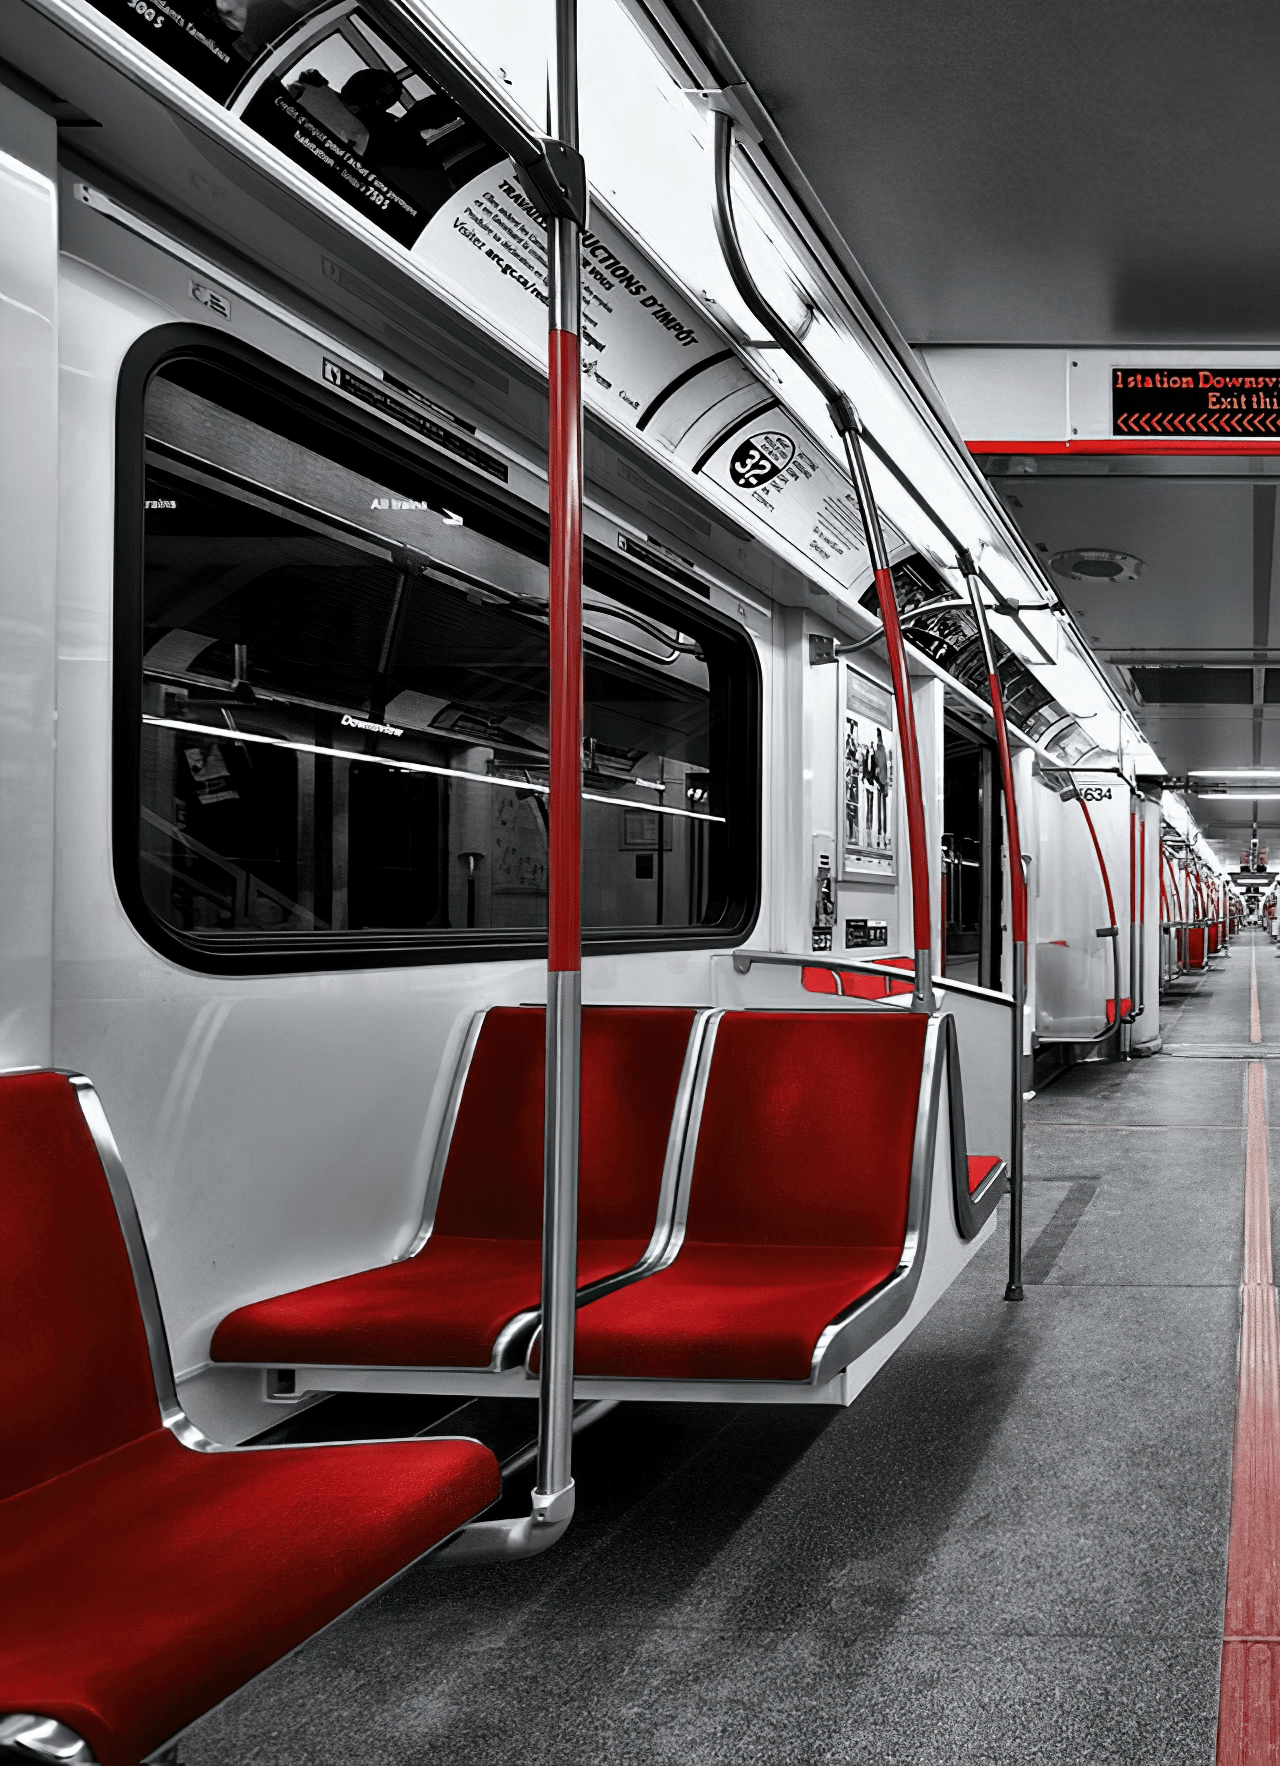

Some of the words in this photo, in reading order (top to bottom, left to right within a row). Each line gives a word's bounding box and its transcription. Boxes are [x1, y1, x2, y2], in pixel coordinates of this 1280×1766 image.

[1127, 371, 1194, 388] station
[1208, 392, 1246, 410] Exit
[144, 499, 177, 509] rains
[341, 714, 404, 737] Downsview
